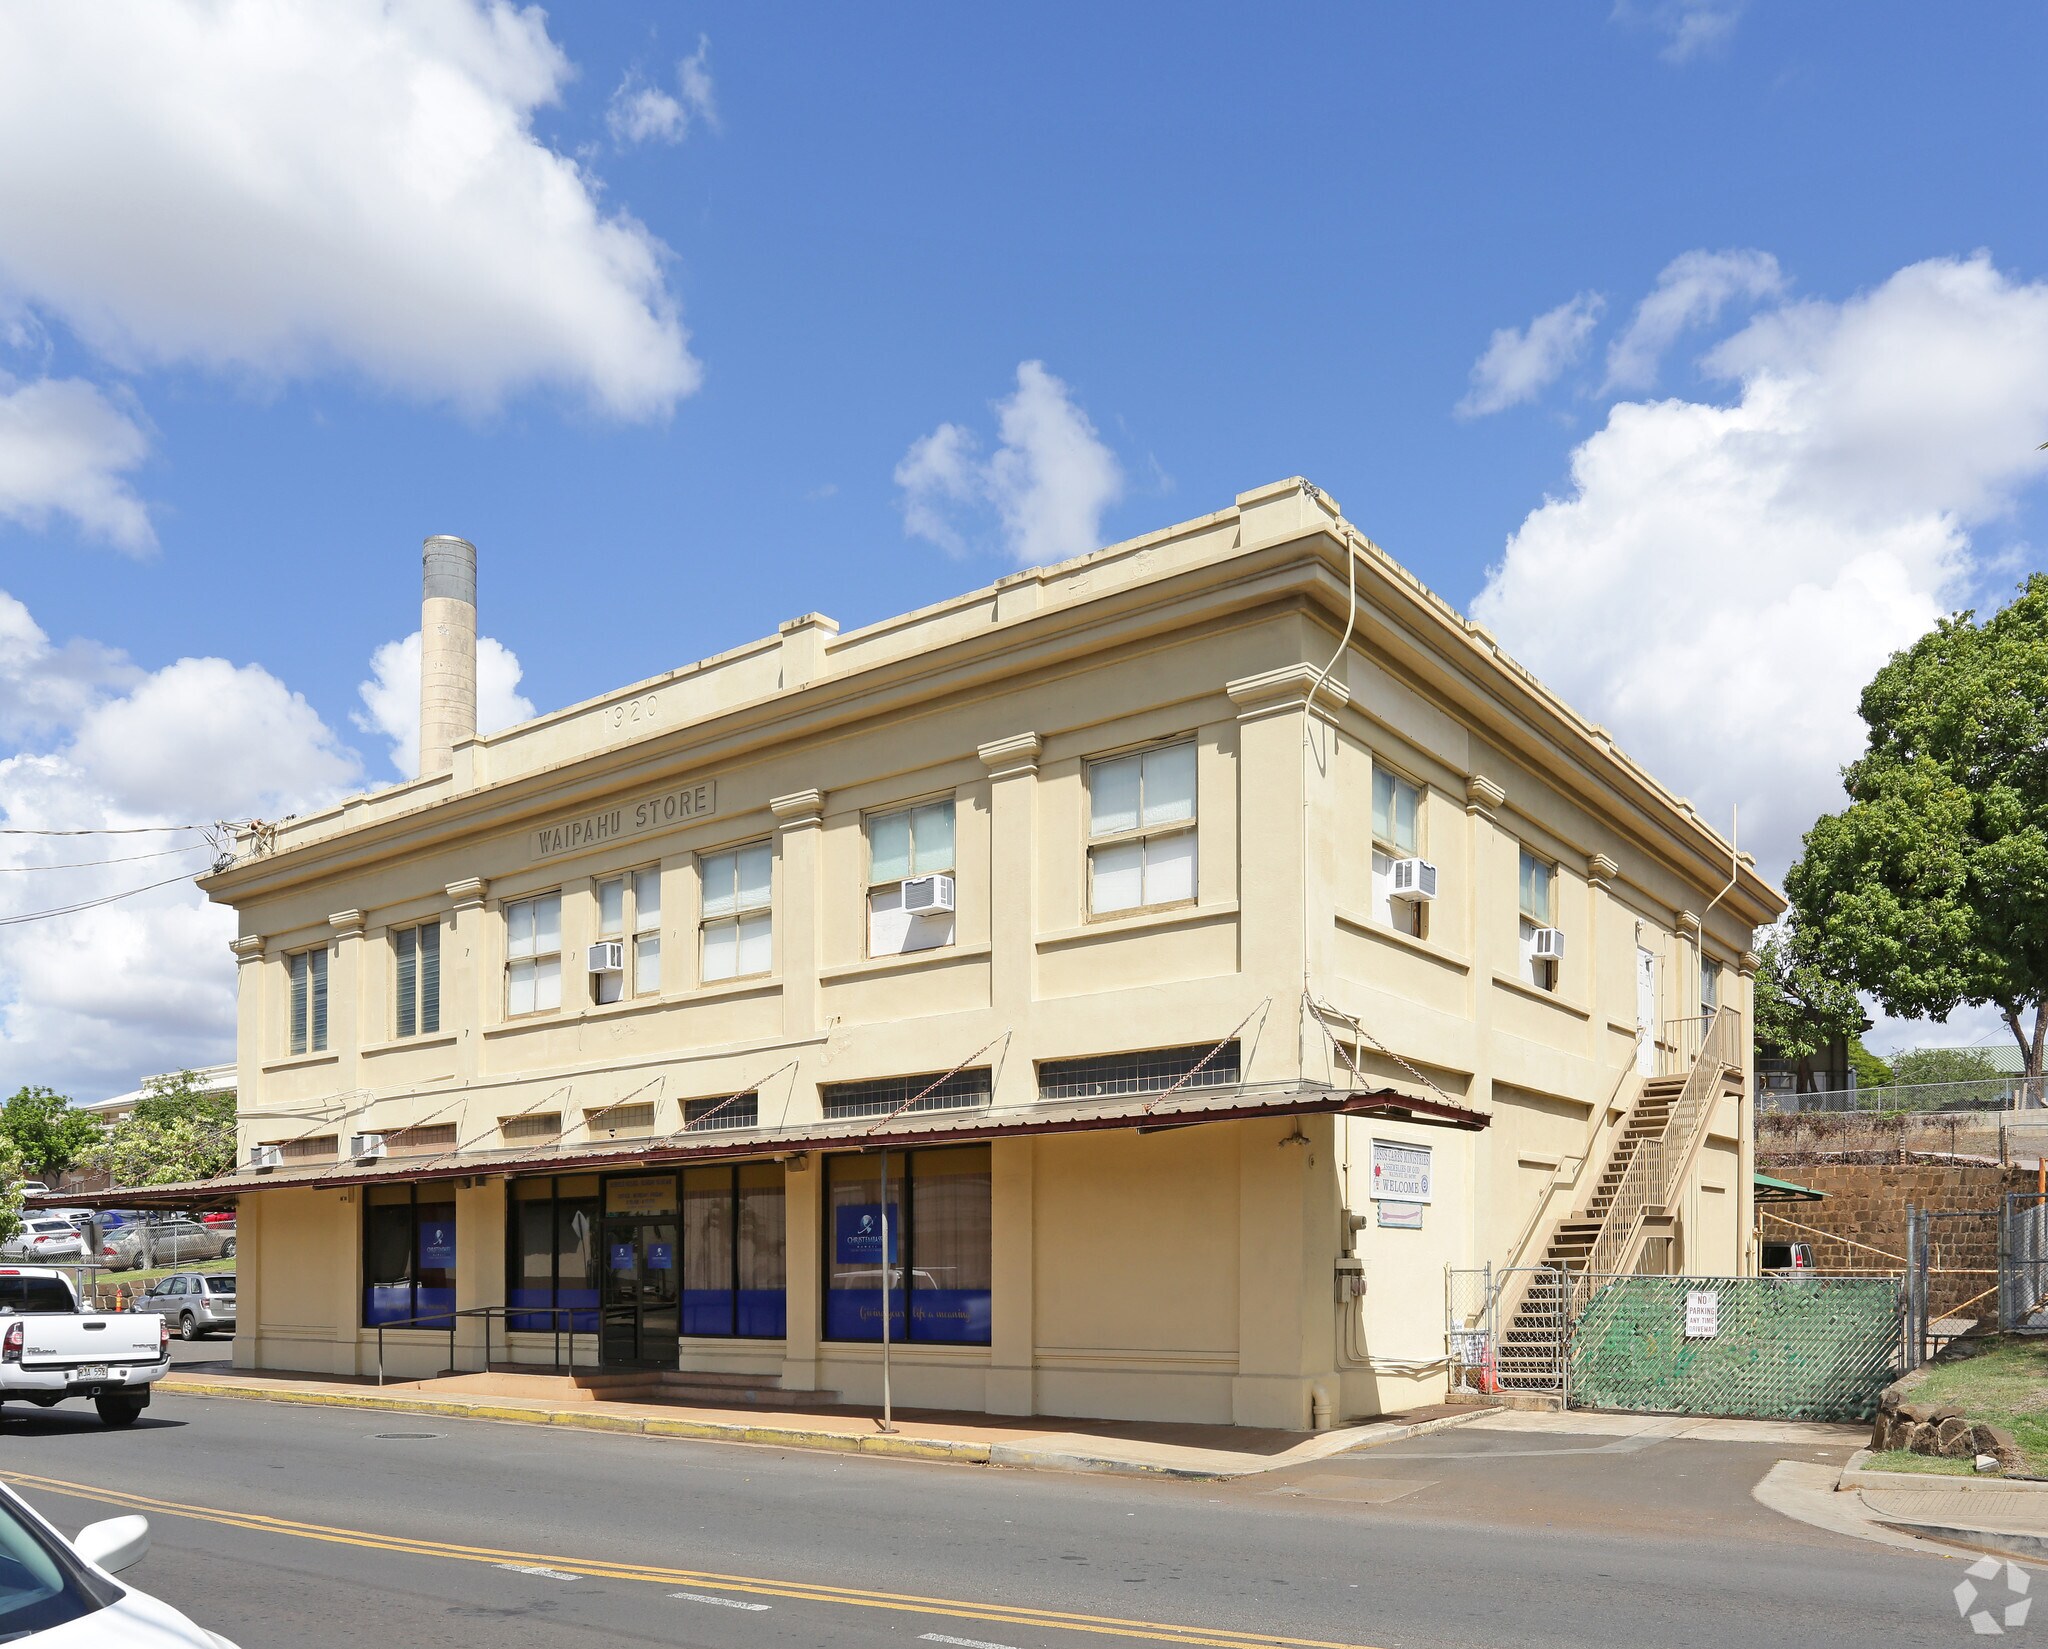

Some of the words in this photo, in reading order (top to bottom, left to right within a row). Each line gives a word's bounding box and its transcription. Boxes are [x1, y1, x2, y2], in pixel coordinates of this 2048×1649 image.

[604, 695, 659, 733] 1920
[538, 810, 622, 855] WAIPAHU
[635, 786, 708, 828] STORE
[1374, 1148, 1388, 1161] JESUS
[1388, 1149, 1403, 1163] CARES
[1404, 1152, 1429, 1166] MINISTRIES
[1382, 1178, 1420, 1194] WELCOME
[1698, 1295, 1707, 1304] NO
[1689, 1307, 1715, 1315] PARKING
[1688, 1325, 1715, 1333] DRIVEWAY
